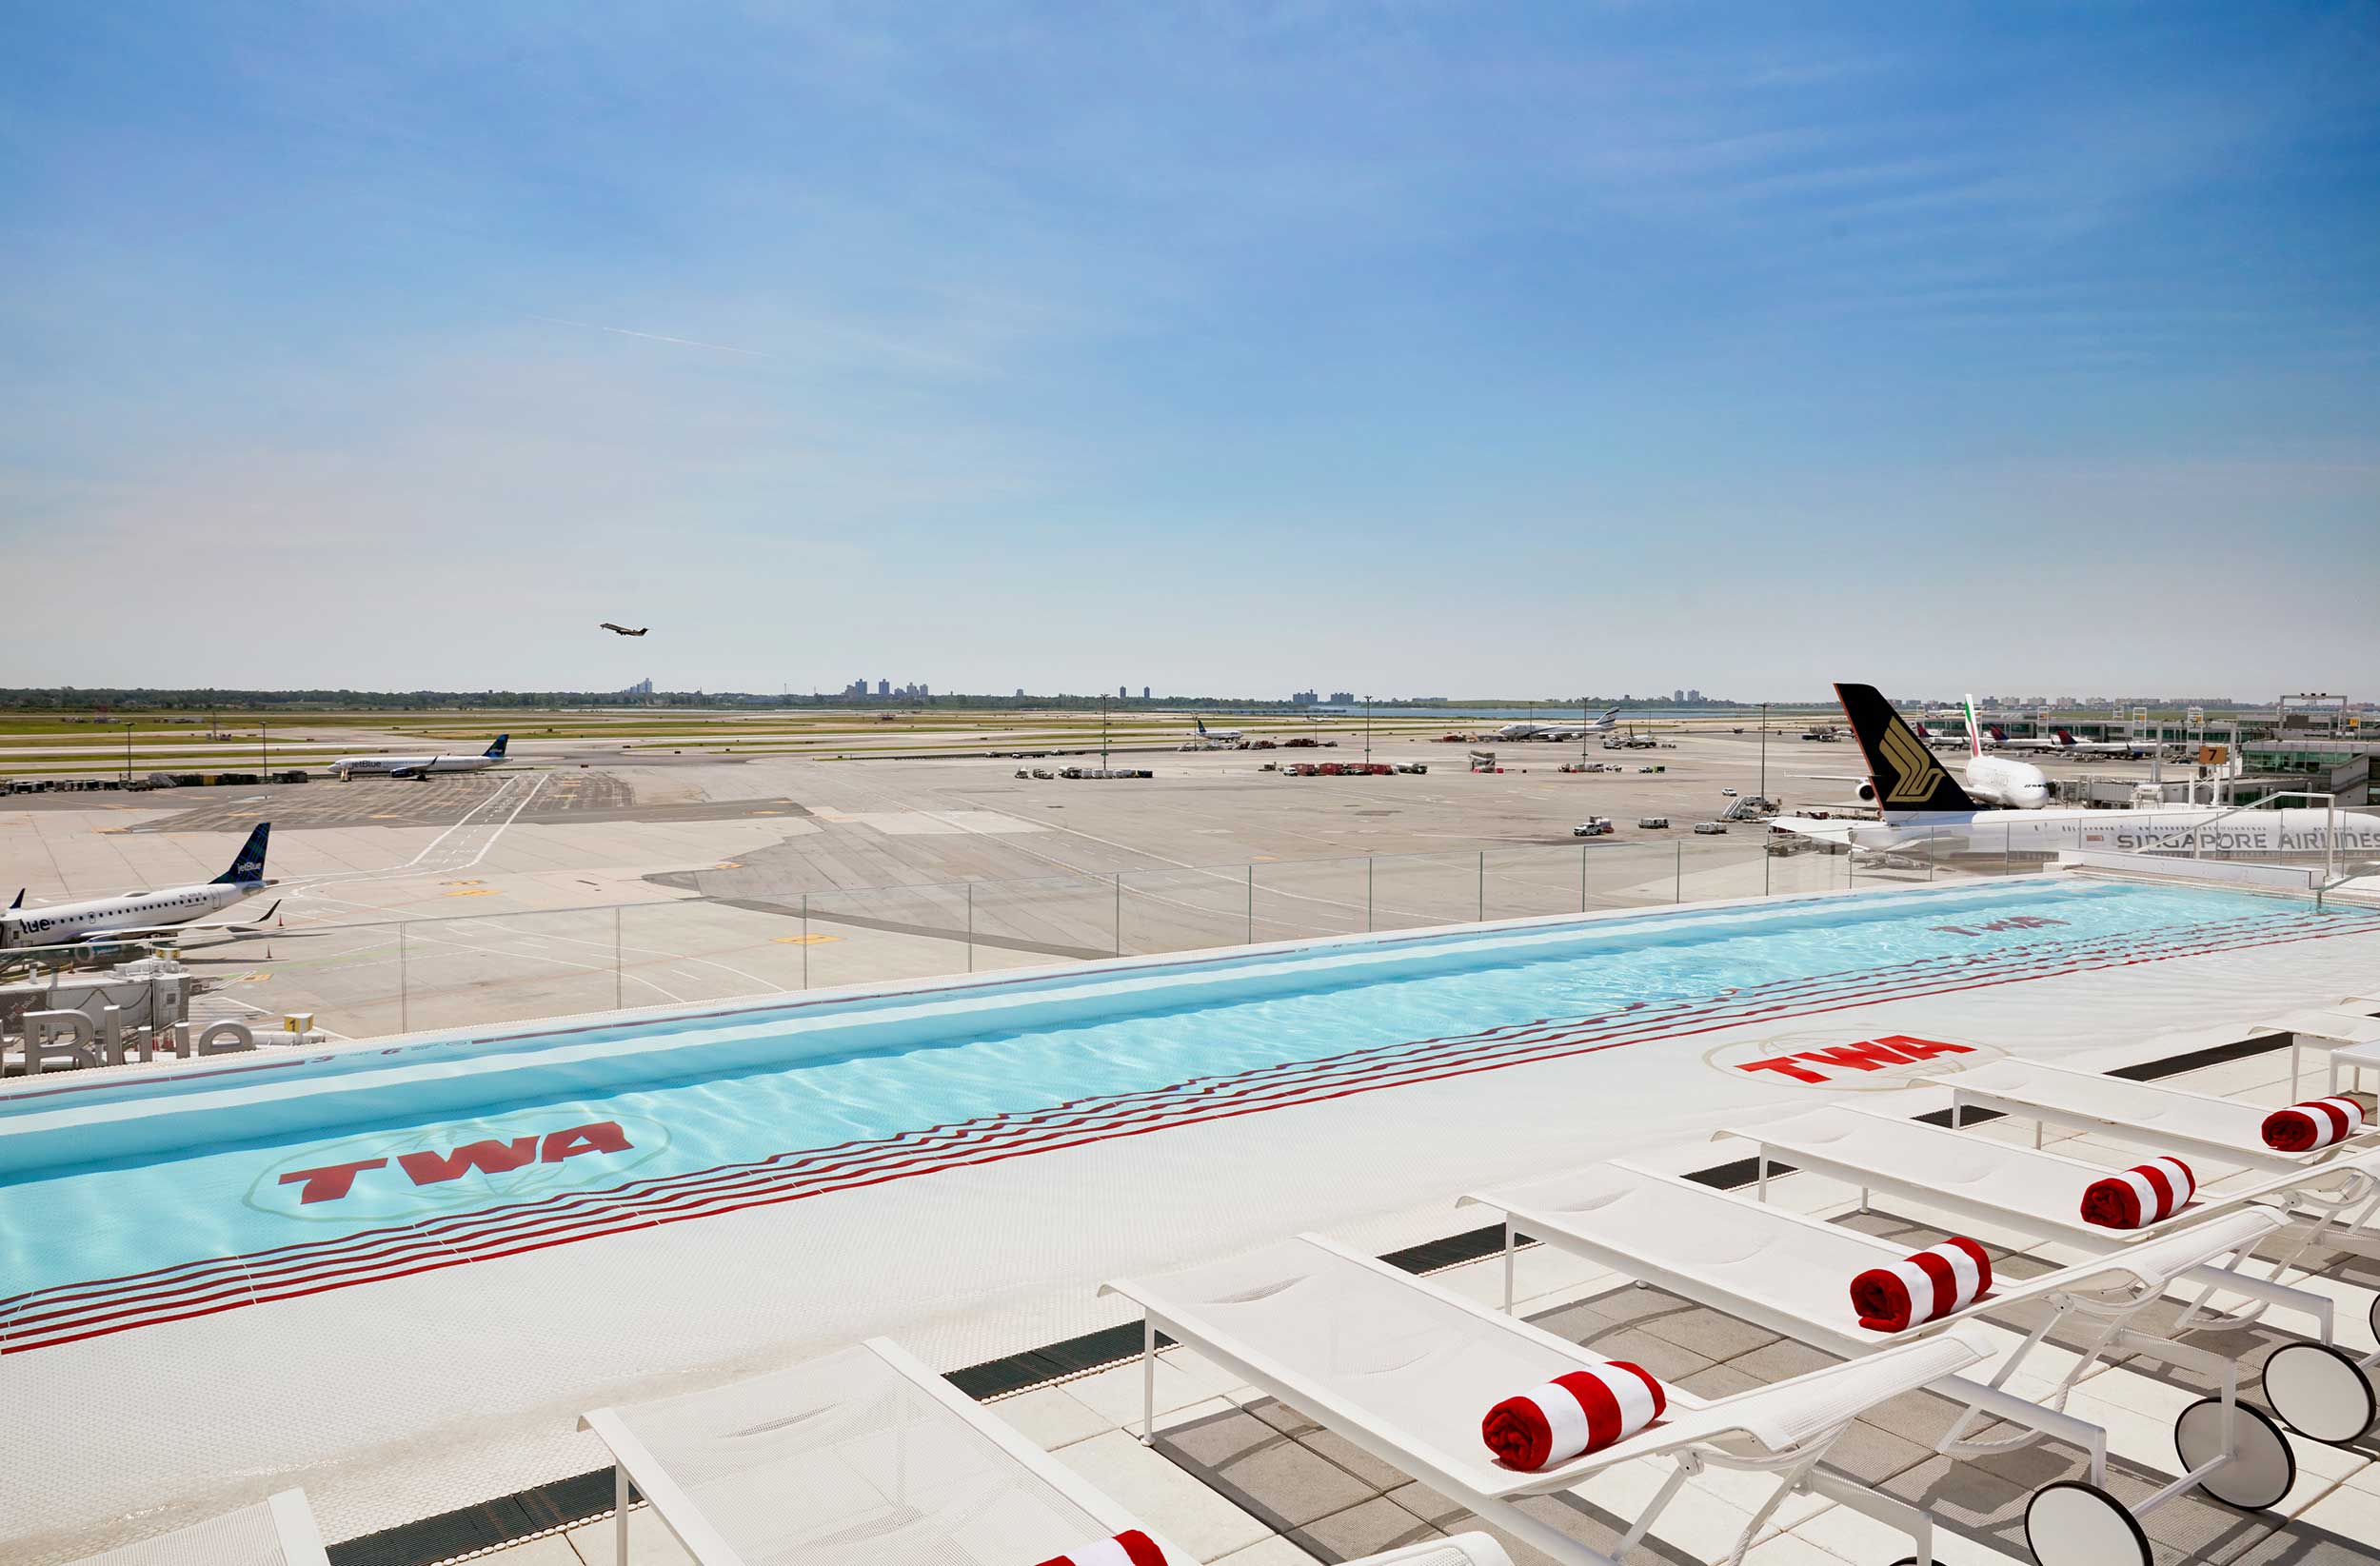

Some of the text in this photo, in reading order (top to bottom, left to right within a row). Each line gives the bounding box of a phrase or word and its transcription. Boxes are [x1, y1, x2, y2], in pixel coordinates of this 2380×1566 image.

[2208, 749, 2217, 762] 7
[351, 760, 382, 769] jetBlue
[2116, 833, 2267, 849] SINGAPORE
[236, 862, 262, 874] jetBlue
[1927, 916, 2073, 937] TWA
[289, 1019, 296, 1032] 1
[0, 1004, 256, 1075] Blue
[1735, 1034, 1978, 1084] TWA
[278, 1120, 635, 1204] TWA
